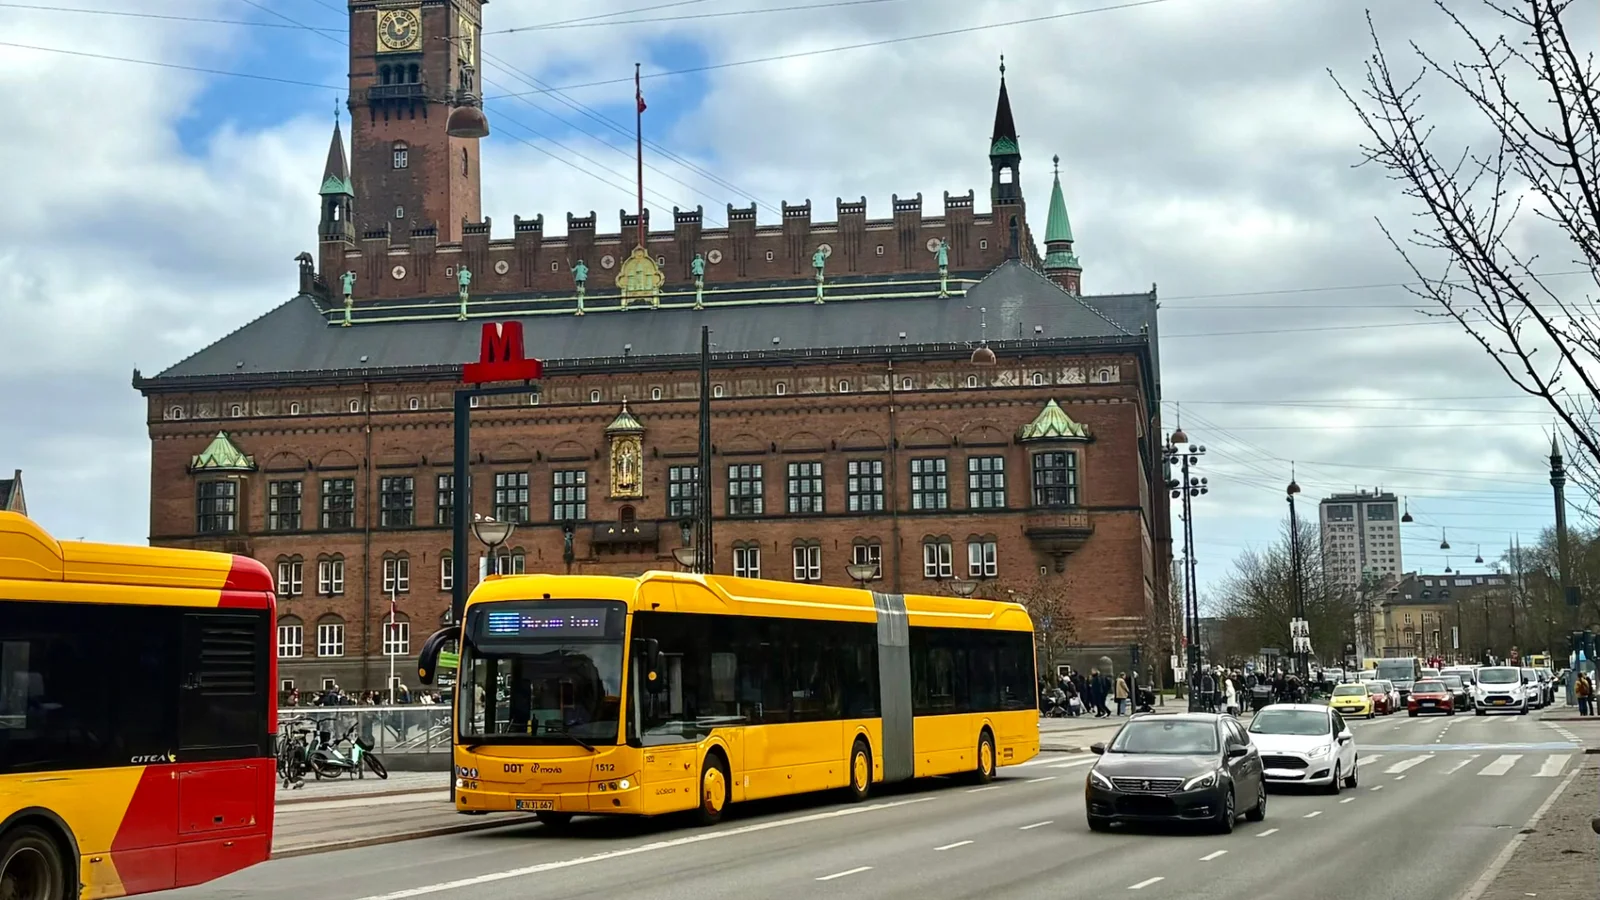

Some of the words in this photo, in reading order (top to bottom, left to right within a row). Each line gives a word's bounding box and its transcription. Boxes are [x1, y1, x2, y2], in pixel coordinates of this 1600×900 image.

[480, 321, 525, 364] M
[130, 754, 166, 763] CITEA
[503, 763, 525, 773] DOT
[595, 763, 615, 772] 1512
